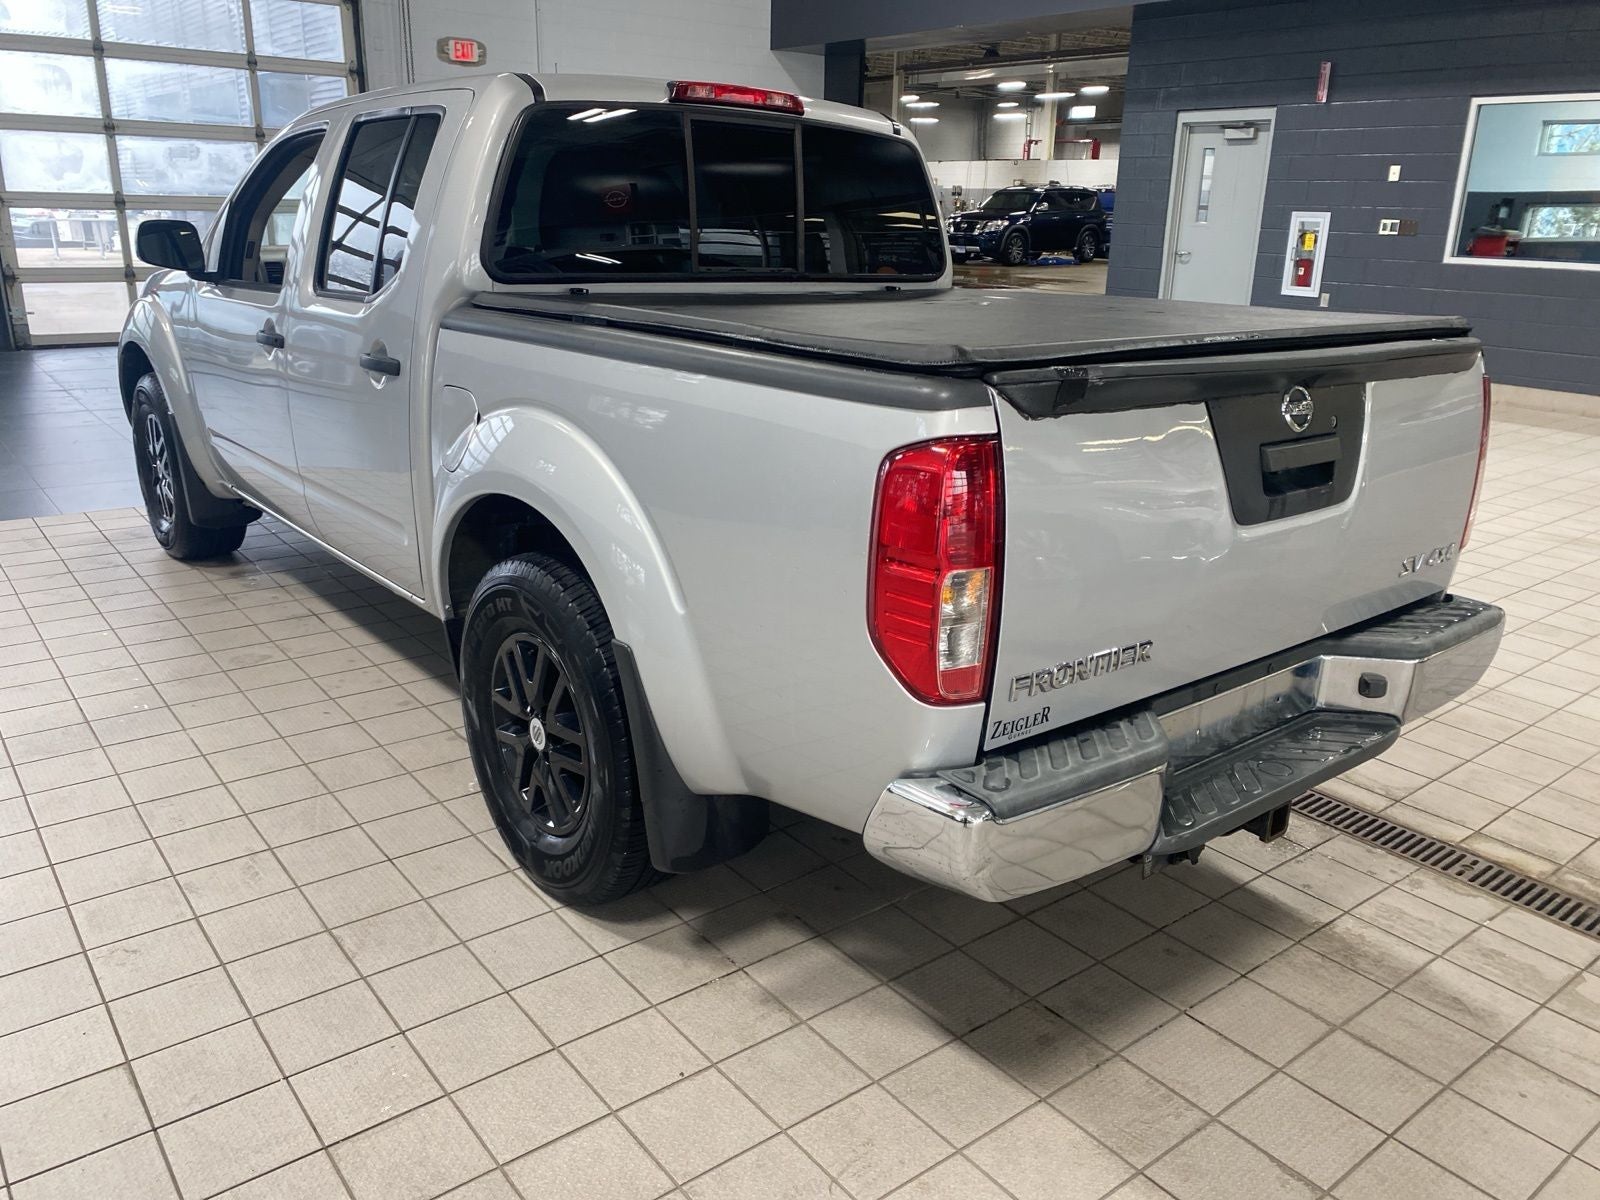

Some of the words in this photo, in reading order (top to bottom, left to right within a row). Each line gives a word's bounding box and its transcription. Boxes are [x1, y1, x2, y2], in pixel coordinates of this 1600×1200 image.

[453, 40, 475, 59] EXIT
[1398, 553, 1425, 577] SV
[1008, 640, 1153, 702] FRONTIER
[991, 706, 1050, 740] ZEIGLER
